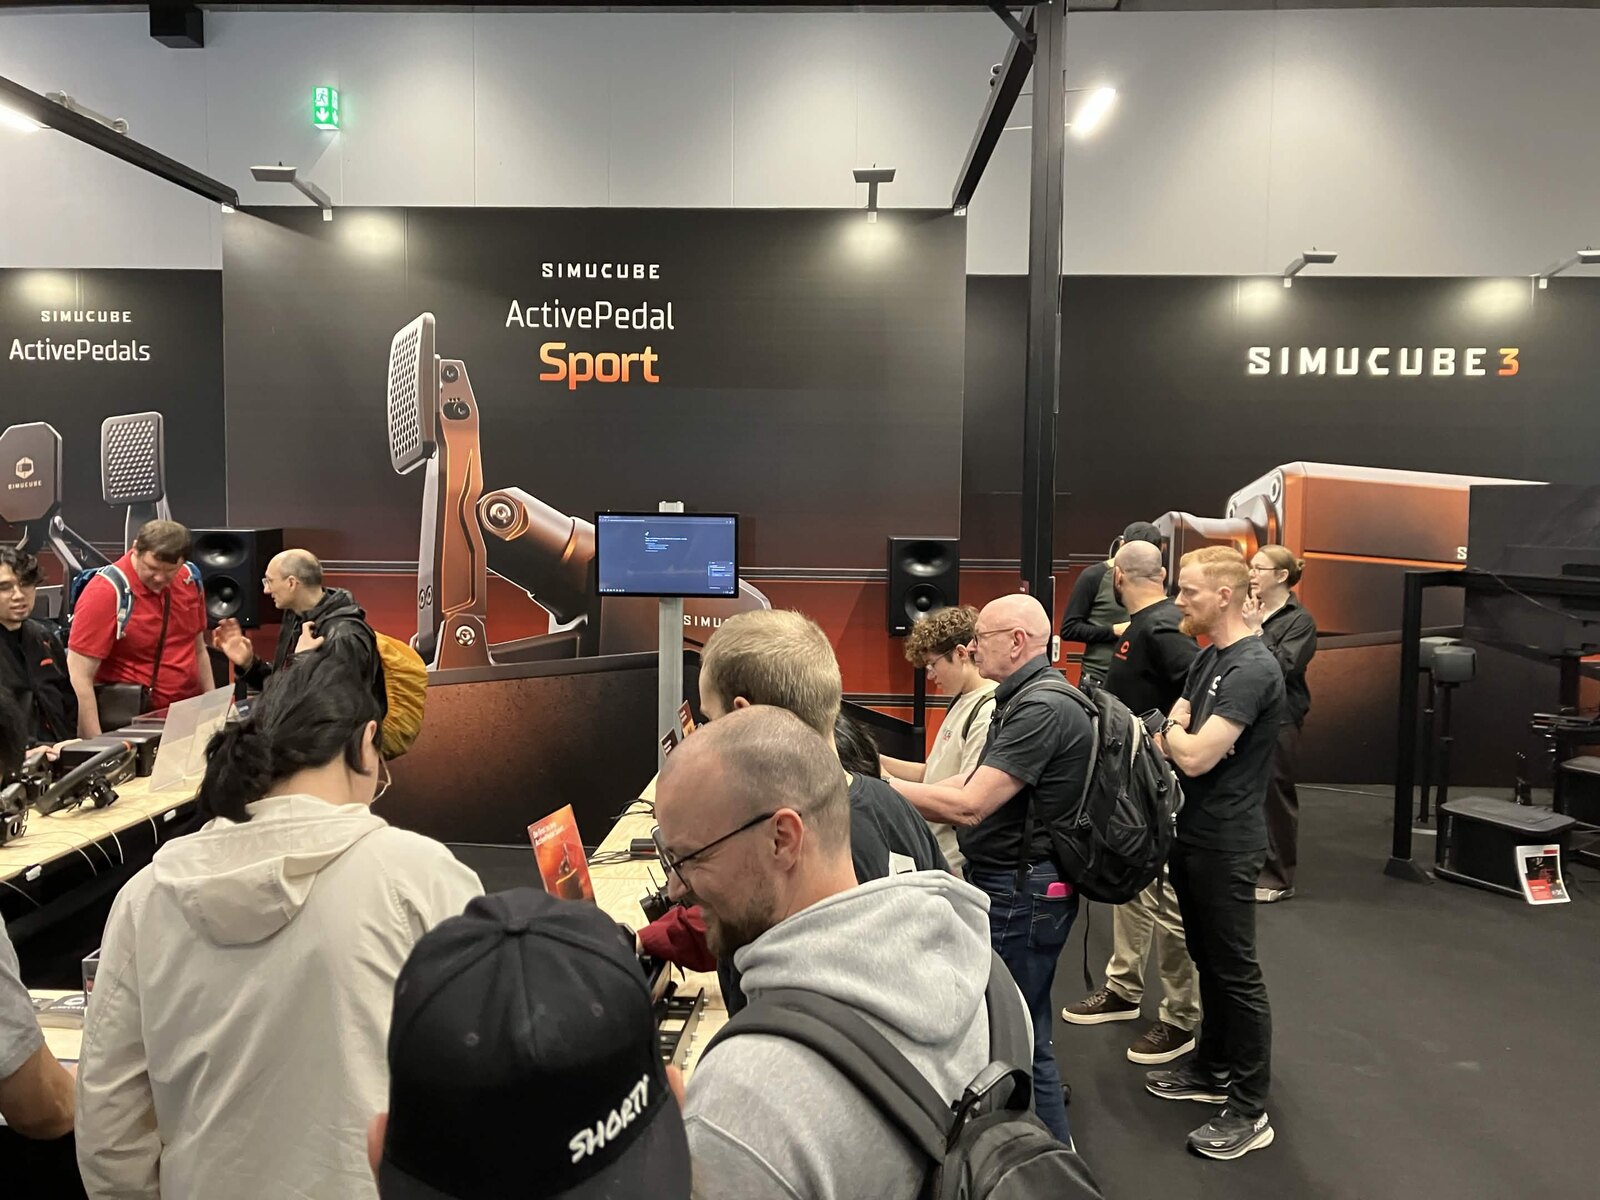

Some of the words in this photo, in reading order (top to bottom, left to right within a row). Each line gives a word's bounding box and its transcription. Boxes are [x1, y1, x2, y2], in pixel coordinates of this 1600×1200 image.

[541, 262, 661, 280] SIMUCUBE
[40, 310, 132, 323] SIMUCUBE
[505, 299, 675, 330] ActivePedal
[8, 338, 151, 362] ActivePedals
[1247, 346, 1488, 377] SIMUCUBE
[1497, 347, 1520, 377] 3
[539, 342, 660, 390] Sport
[683, 614, 729, 628] SIMU
